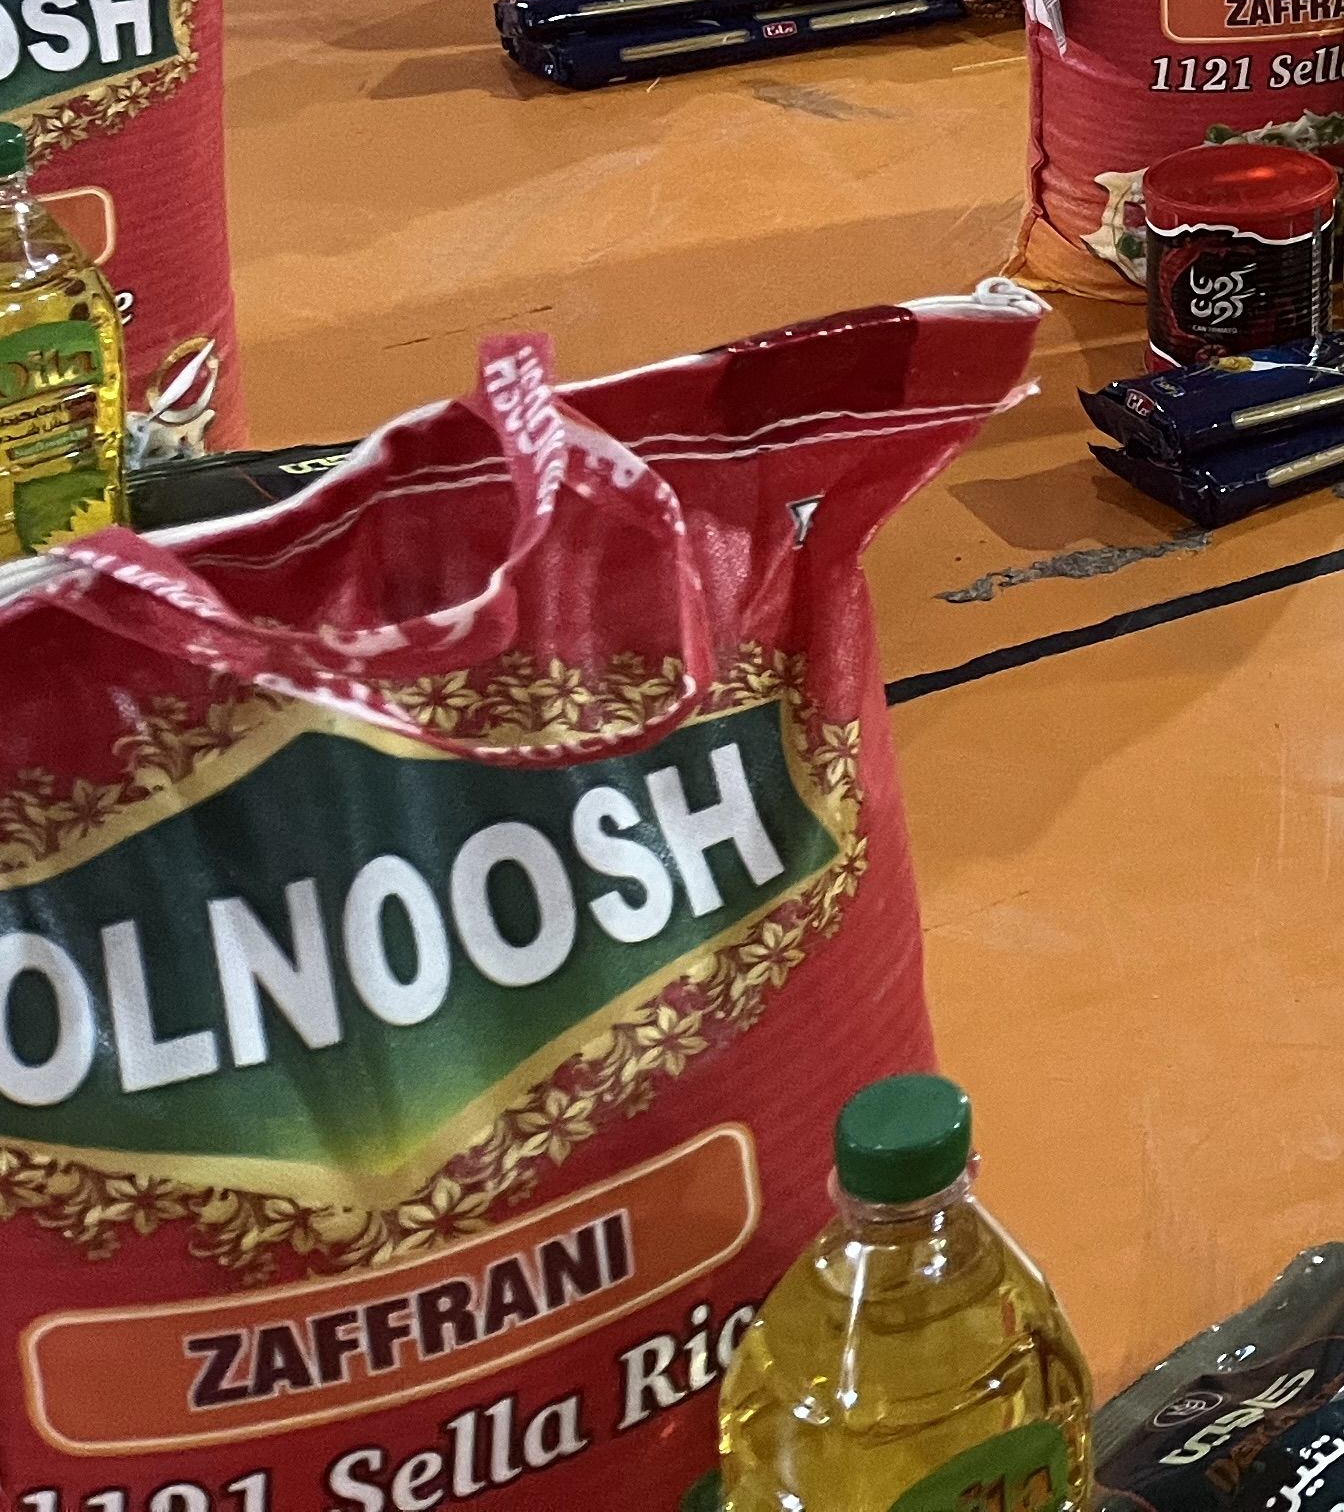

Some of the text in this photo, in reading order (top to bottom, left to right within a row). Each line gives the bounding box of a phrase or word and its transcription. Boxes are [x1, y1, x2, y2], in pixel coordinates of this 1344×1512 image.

[1152, 58, 1251, 91] 1121
[1190, 263, 1256, 300] گونا
[0, 742, 784, 1105] OLNOOSH
[186, 1209, 633, 1413] ZAFFRANI
